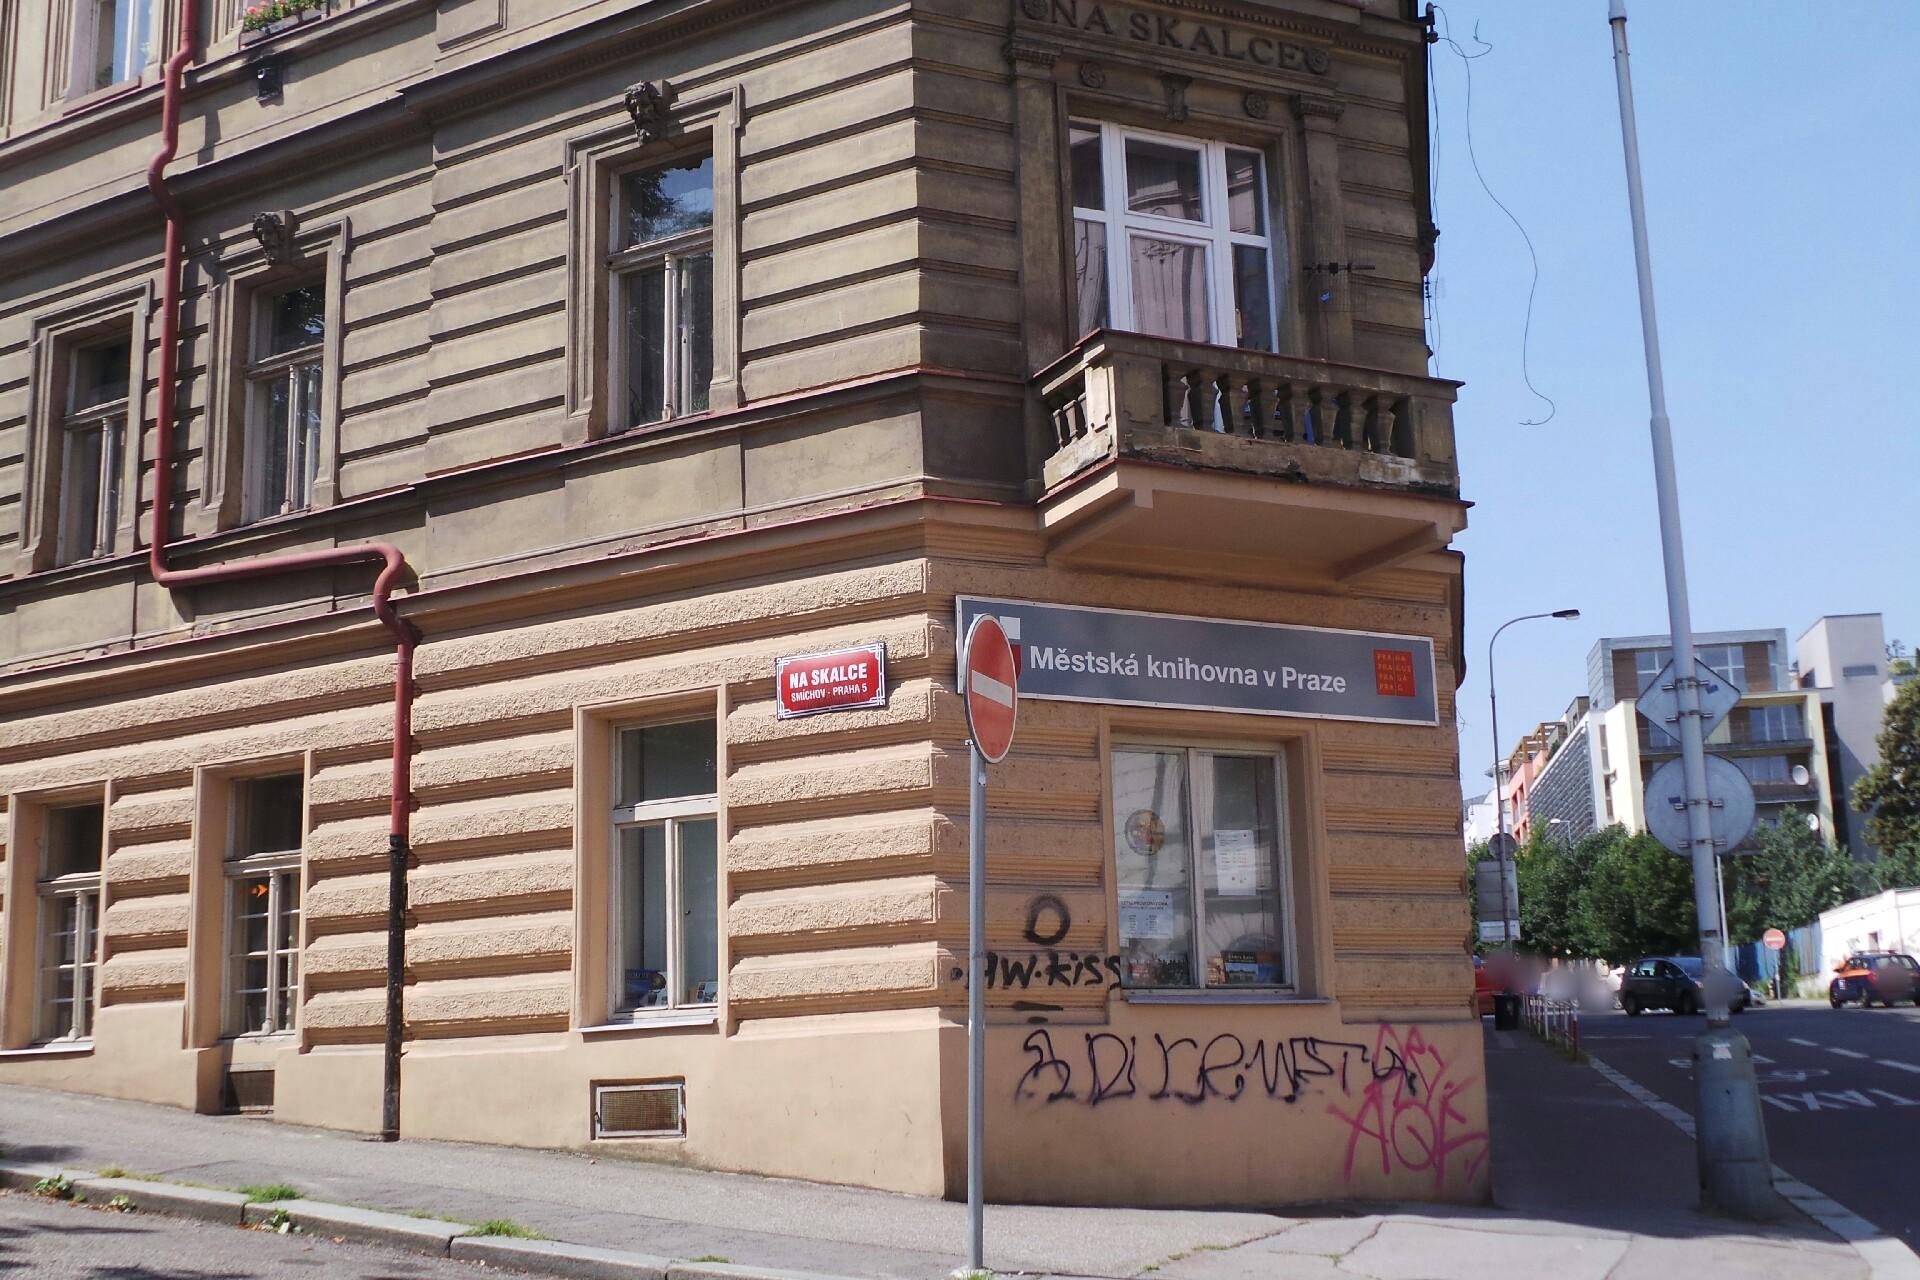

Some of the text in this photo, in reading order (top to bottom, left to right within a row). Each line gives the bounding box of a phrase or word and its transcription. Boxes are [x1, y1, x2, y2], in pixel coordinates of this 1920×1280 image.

[1050, 0, 1303, 70] NA SKALCE
[789, 663, 867, 689] NA SKALCE
[1029, 645, 1347, 694] Městská knihovna v Praze
[791, 688, 826, 702] SMÍCHOV
[832, 684, 860, 697] PRAHA
[862, 682, 868, 693] 5
